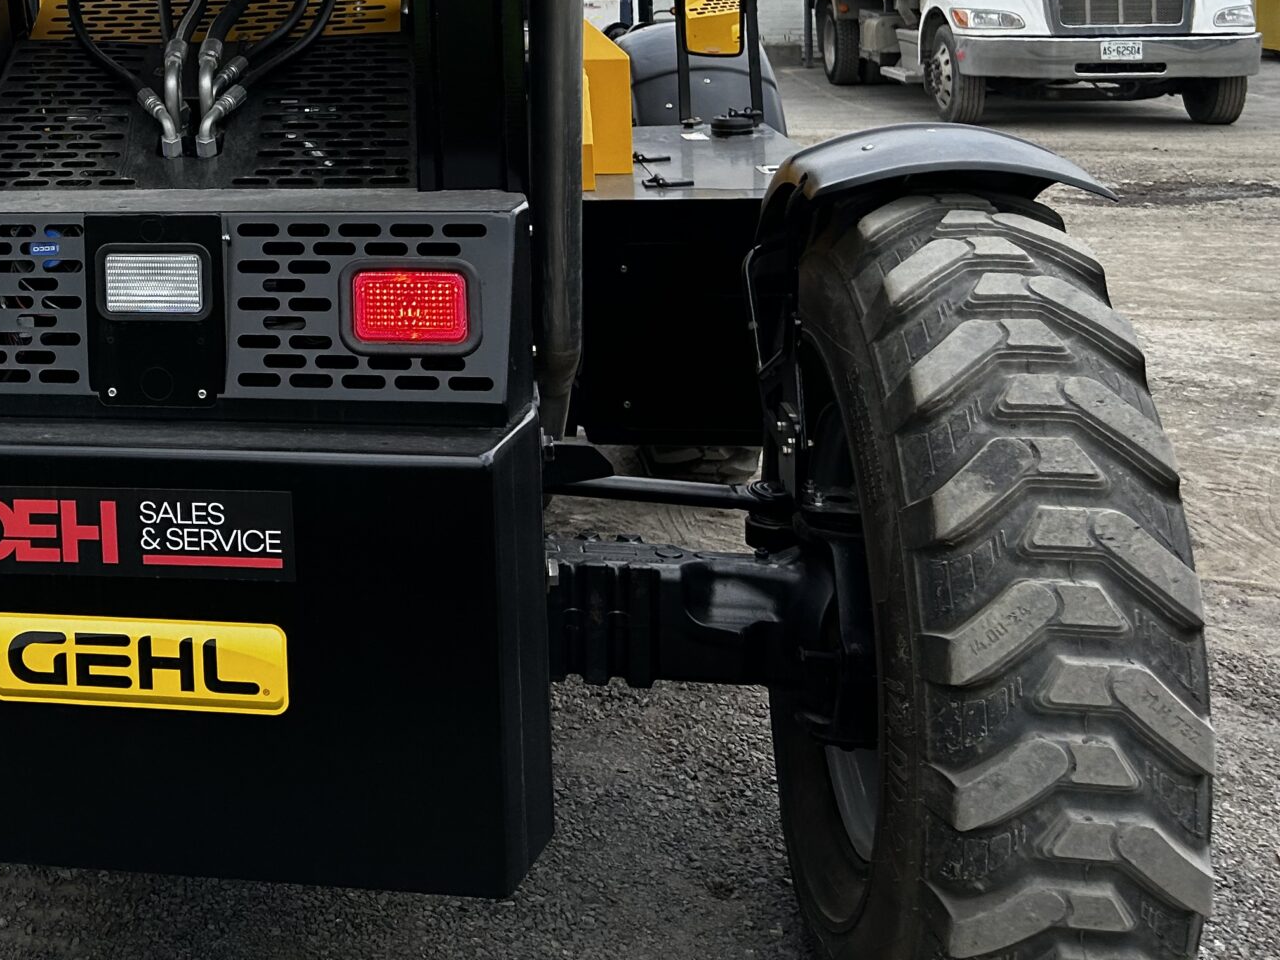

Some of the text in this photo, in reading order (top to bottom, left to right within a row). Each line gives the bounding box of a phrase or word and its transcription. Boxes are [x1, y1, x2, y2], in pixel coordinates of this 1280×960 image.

[139, 501, 225, 525] SALES
[140, 528, 283, 553] & SERVICE
[7, 630, 261, 695] GEHL
